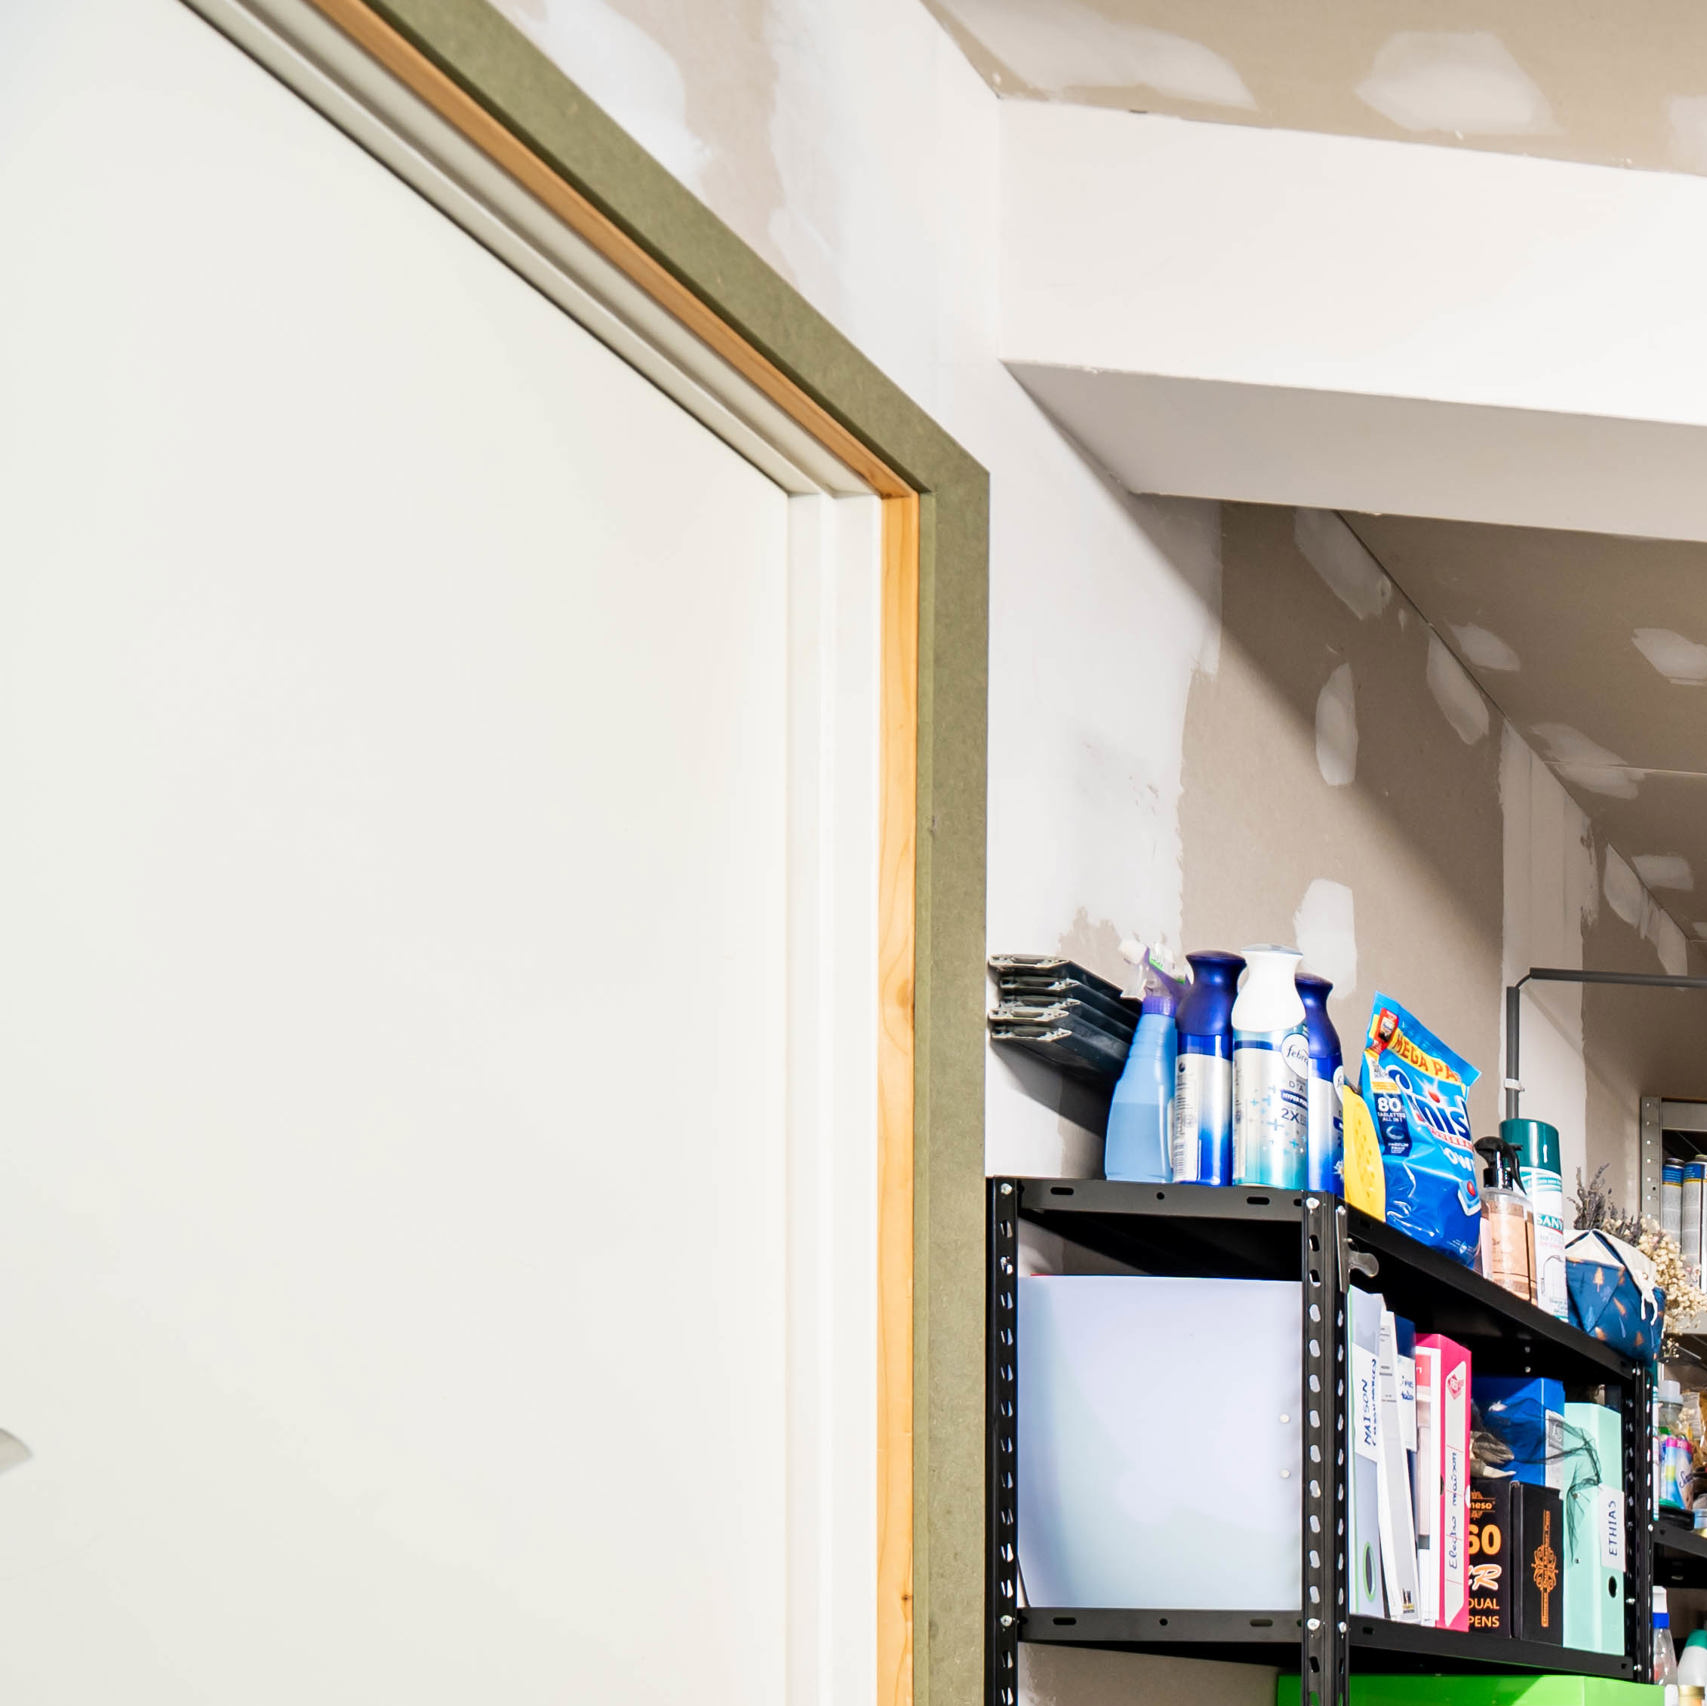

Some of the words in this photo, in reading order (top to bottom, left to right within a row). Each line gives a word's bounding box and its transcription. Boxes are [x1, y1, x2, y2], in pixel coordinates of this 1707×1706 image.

[1392, 1034, 1429, 1072] MEGA
[1378, 1097, 1402, 1112] 80
[1608, 1500, 1618, 1557] ETHIAS
